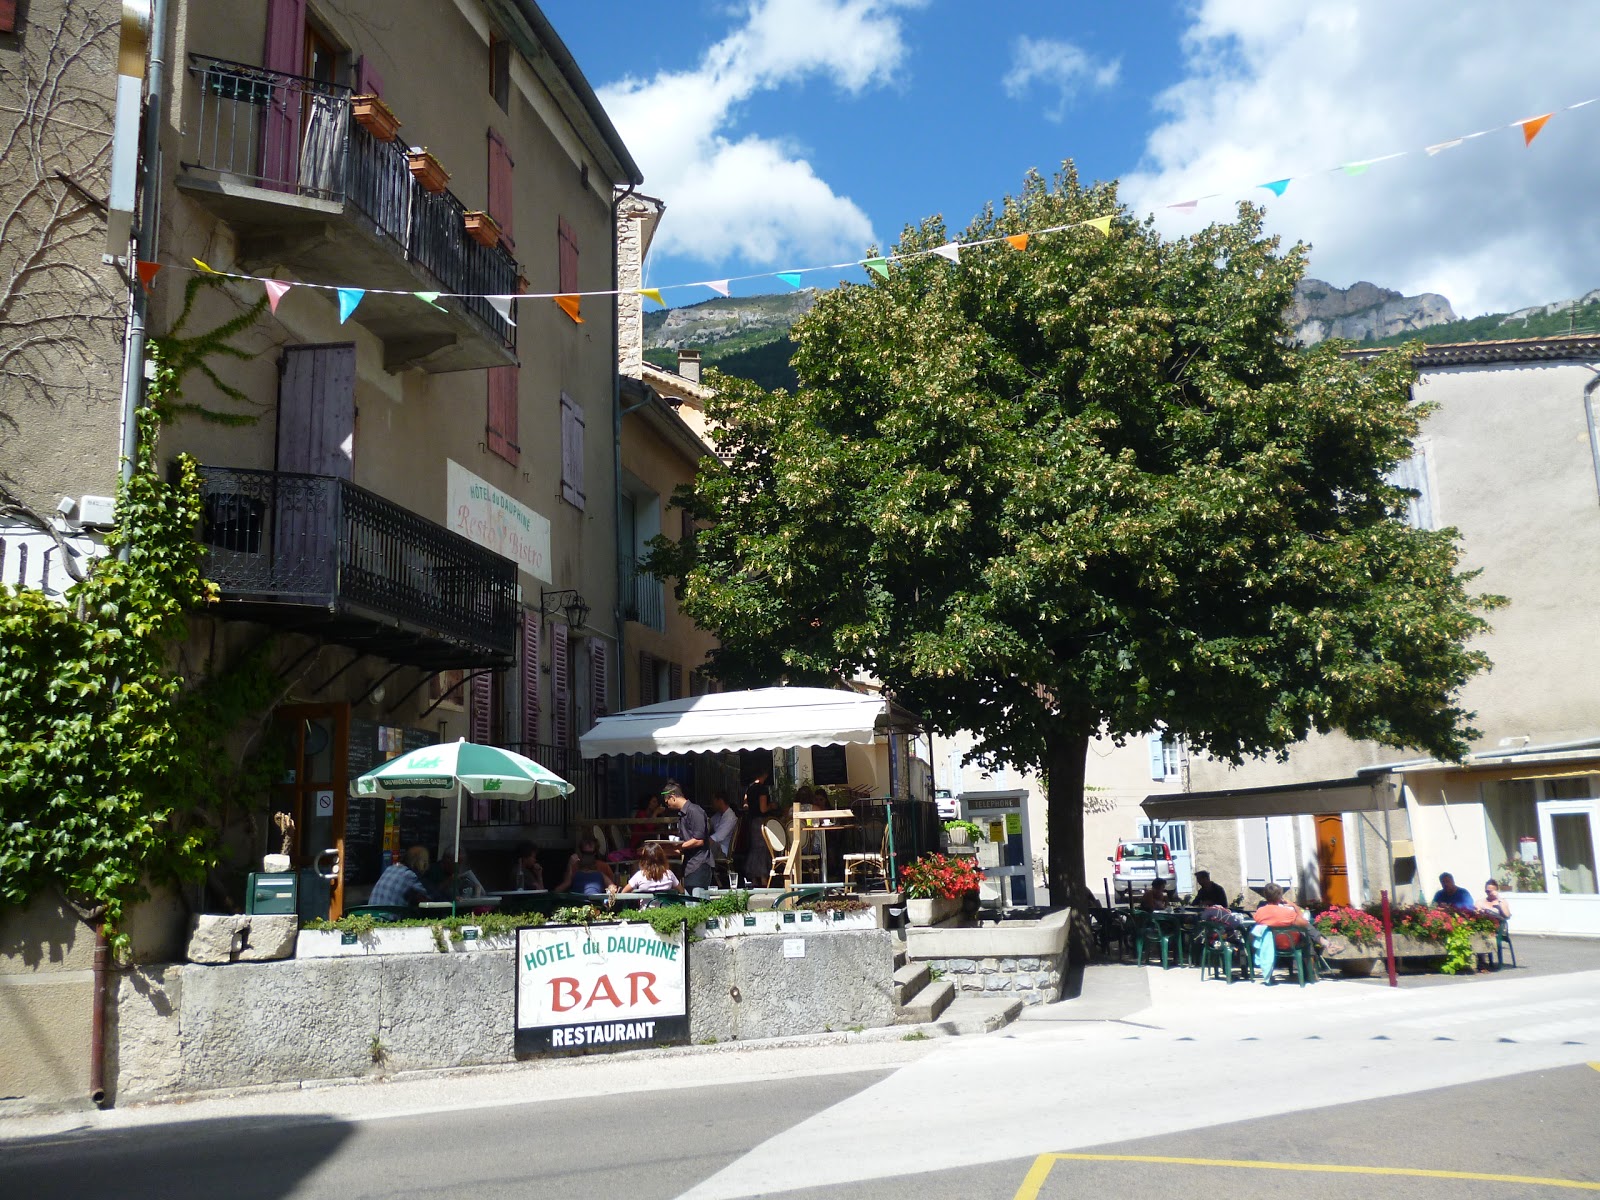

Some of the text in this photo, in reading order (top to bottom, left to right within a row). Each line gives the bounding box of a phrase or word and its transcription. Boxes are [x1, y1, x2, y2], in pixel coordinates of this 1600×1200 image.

[492, 491, 500, 506] du
[458, 505, 543, 569] Resto Bistro
[583, 937, 600, 955] du
[607, 936, 681, 962] DAUPHINE
[546, 971, 662, 1012] BAR
[552, 1021, 656, 1047] RESTAURANT
